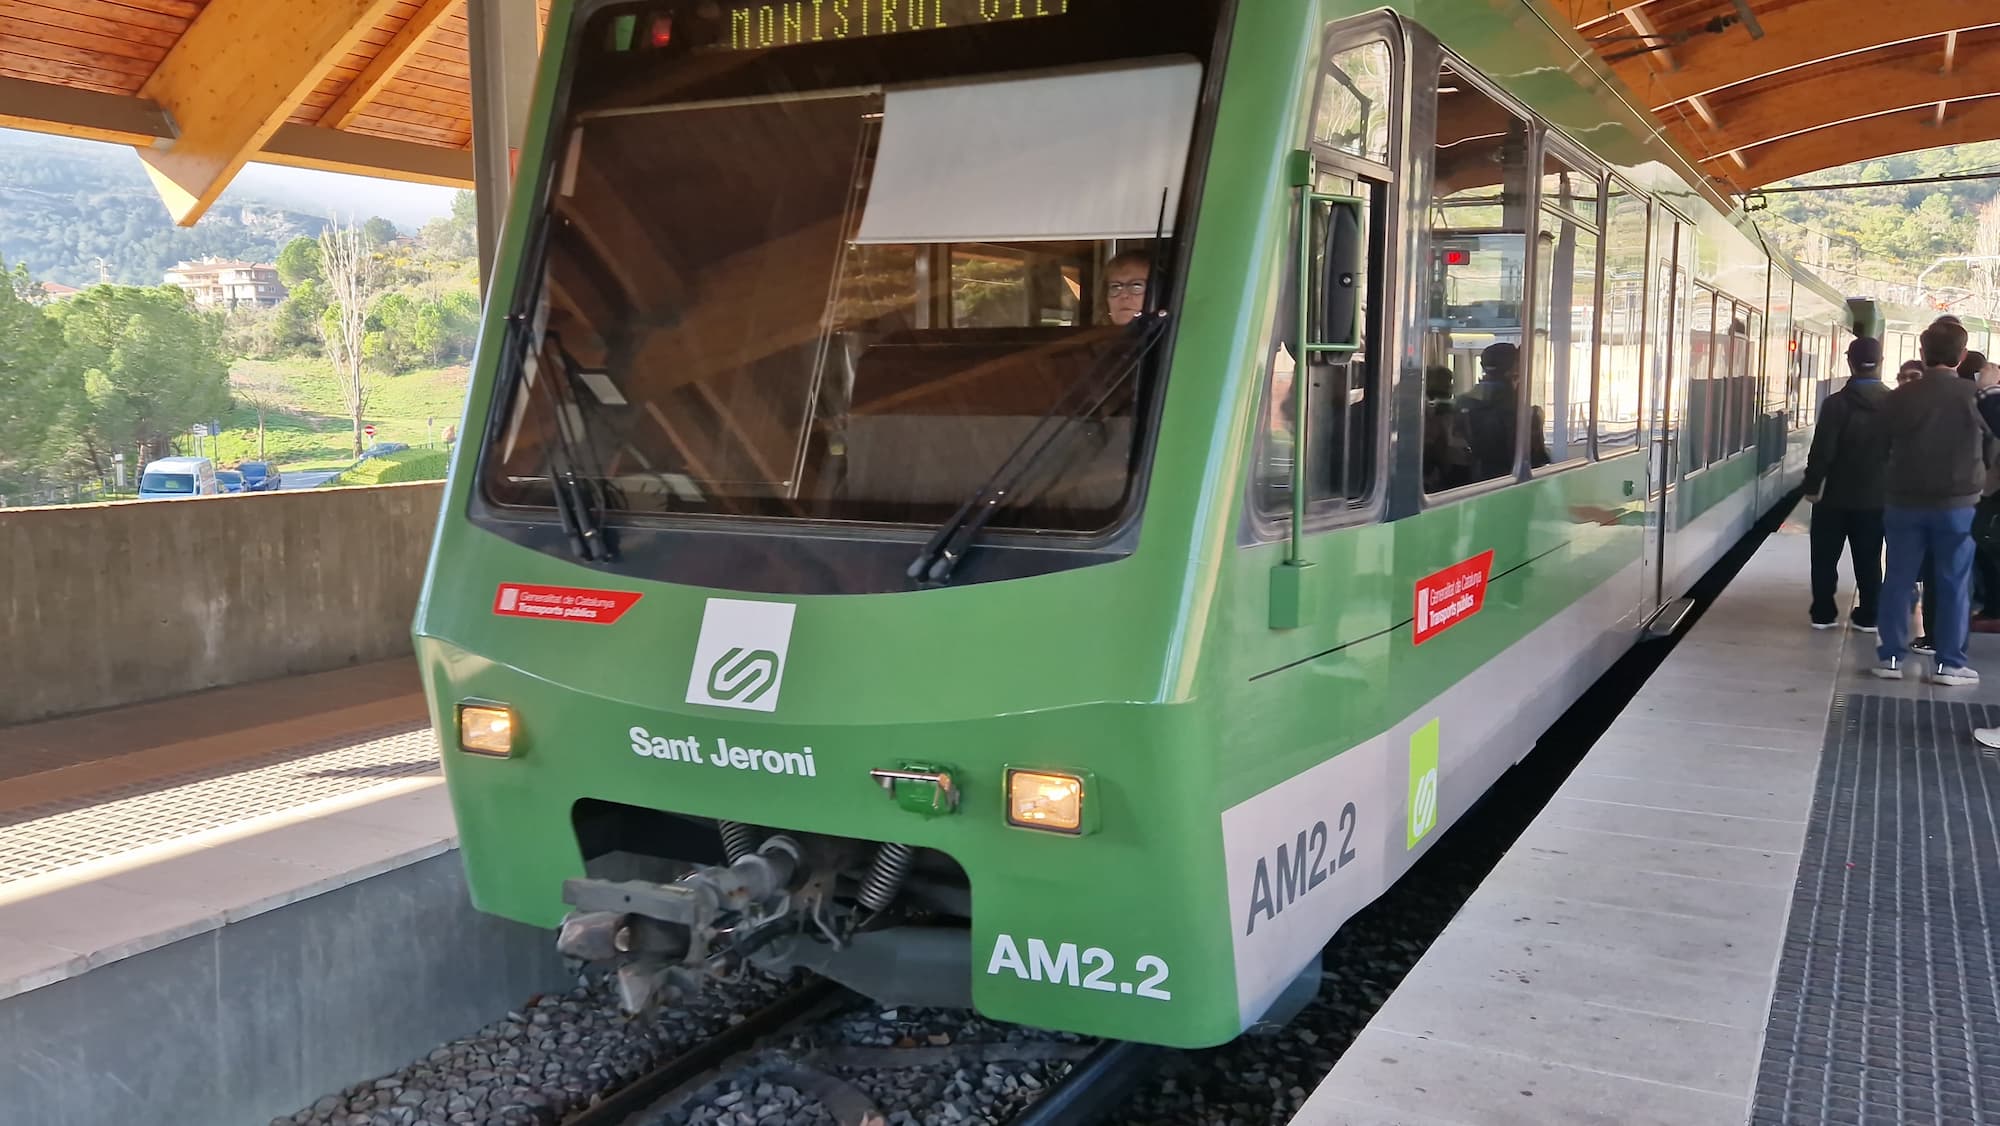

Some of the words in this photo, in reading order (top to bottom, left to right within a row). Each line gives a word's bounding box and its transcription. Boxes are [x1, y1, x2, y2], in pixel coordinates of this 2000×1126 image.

[518, 602, 563, 616] Transports
[628, 726, 704, 764] Sant
[710, 737, 816, 777] Jeroni
[1246, 801, 1356, 937] AM2.2
[986, 933, 1171, 1001] AM2.2
